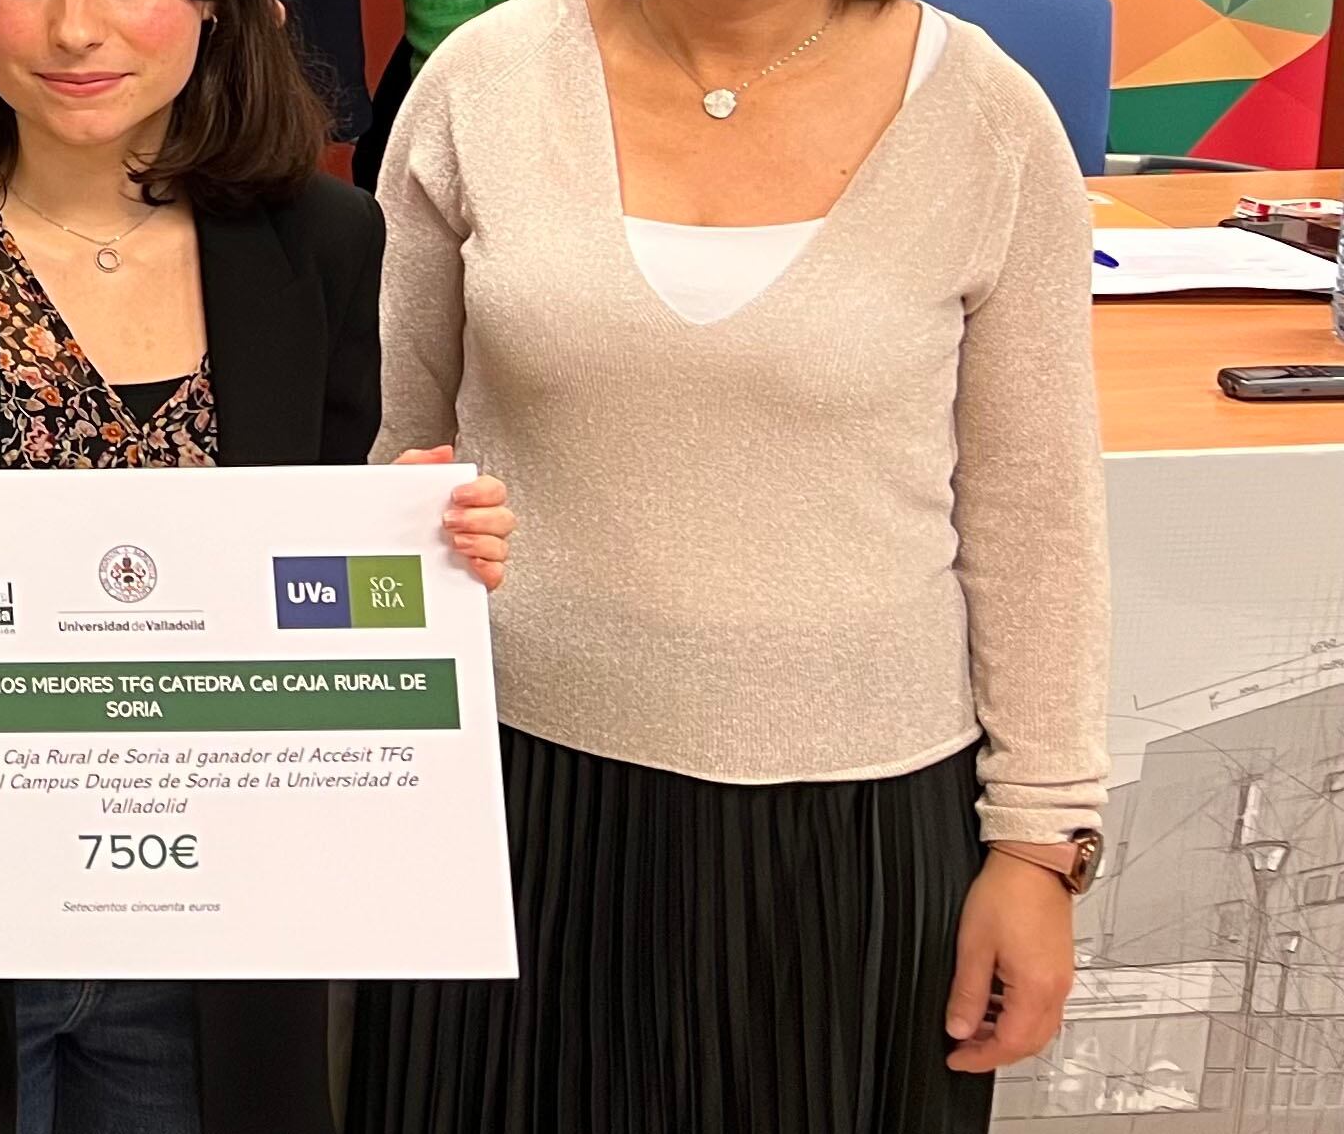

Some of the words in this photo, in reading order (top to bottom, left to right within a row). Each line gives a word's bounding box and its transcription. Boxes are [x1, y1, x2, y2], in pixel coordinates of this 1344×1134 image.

[287, 581, 337, 604] UVa
[371, 592, 405, 608] RIA
[31, 676, 115, 694] MEJORES
[117, 675, 155, 693] TFG
[158, 674, 246, 693] CATEDRA
[282, 674, 330, 692] CAJA
[333, 673, 396, 691] RURAL
[399, 673, 427, 691] DE
[105, 700, 164, 718] SORIA
[3, 749, 41, 770] Caja
[46, 748, 93, 765] Rural
[97, 748, 120, 764] de
[124, 748, 170, 764] Soria
[175, 748, 193, 764] al
[195, 747, 273, 769] ganador
[276, 747, 305, 763] del
[308, 747, 374, 763] Accésit
[380, 746, 415, 762] TFG
[10, 773, 80, 794] Campus
[85, 773, 153, 794] Duques
[158, 773, 181, 789] de
[184, 772, 231, 789] Soria
[237, 772, 260, 788] de
[265, 772, 281, 788] la
[287, 771, 392, 788] Universidad
[396, 771, 420, 787] de
[101, 797, 188, 814] Valladolid
[78, 833, 199, 870] 750€
